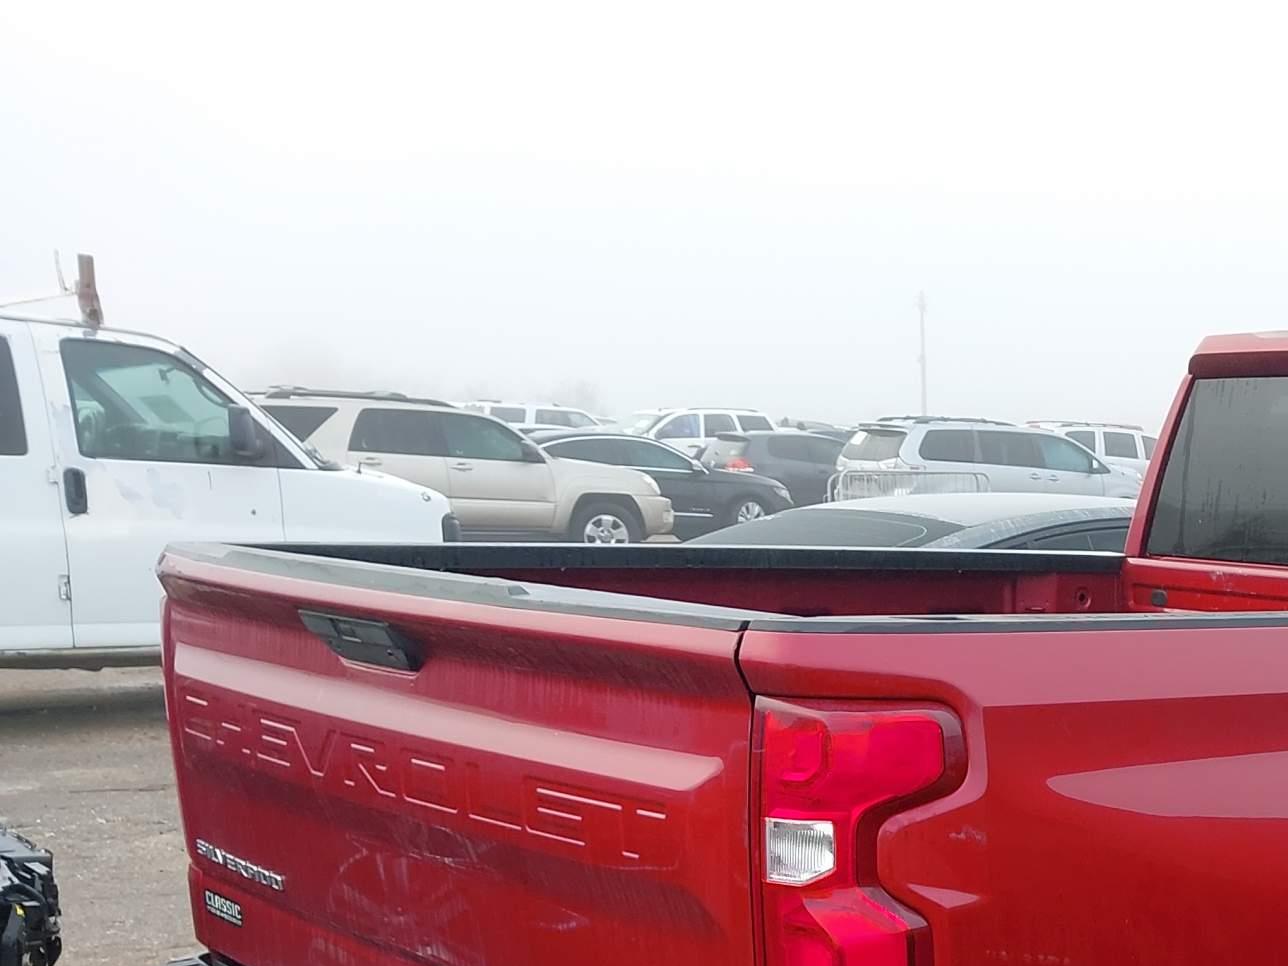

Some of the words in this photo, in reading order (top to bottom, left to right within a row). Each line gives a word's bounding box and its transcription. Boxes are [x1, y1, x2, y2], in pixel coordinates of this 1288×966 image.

[182, 690, 670, 862] CHEVROLET
[195, 838, 286, 891] SILVERADO
[205, 889, 243, 920] CLASSIC
